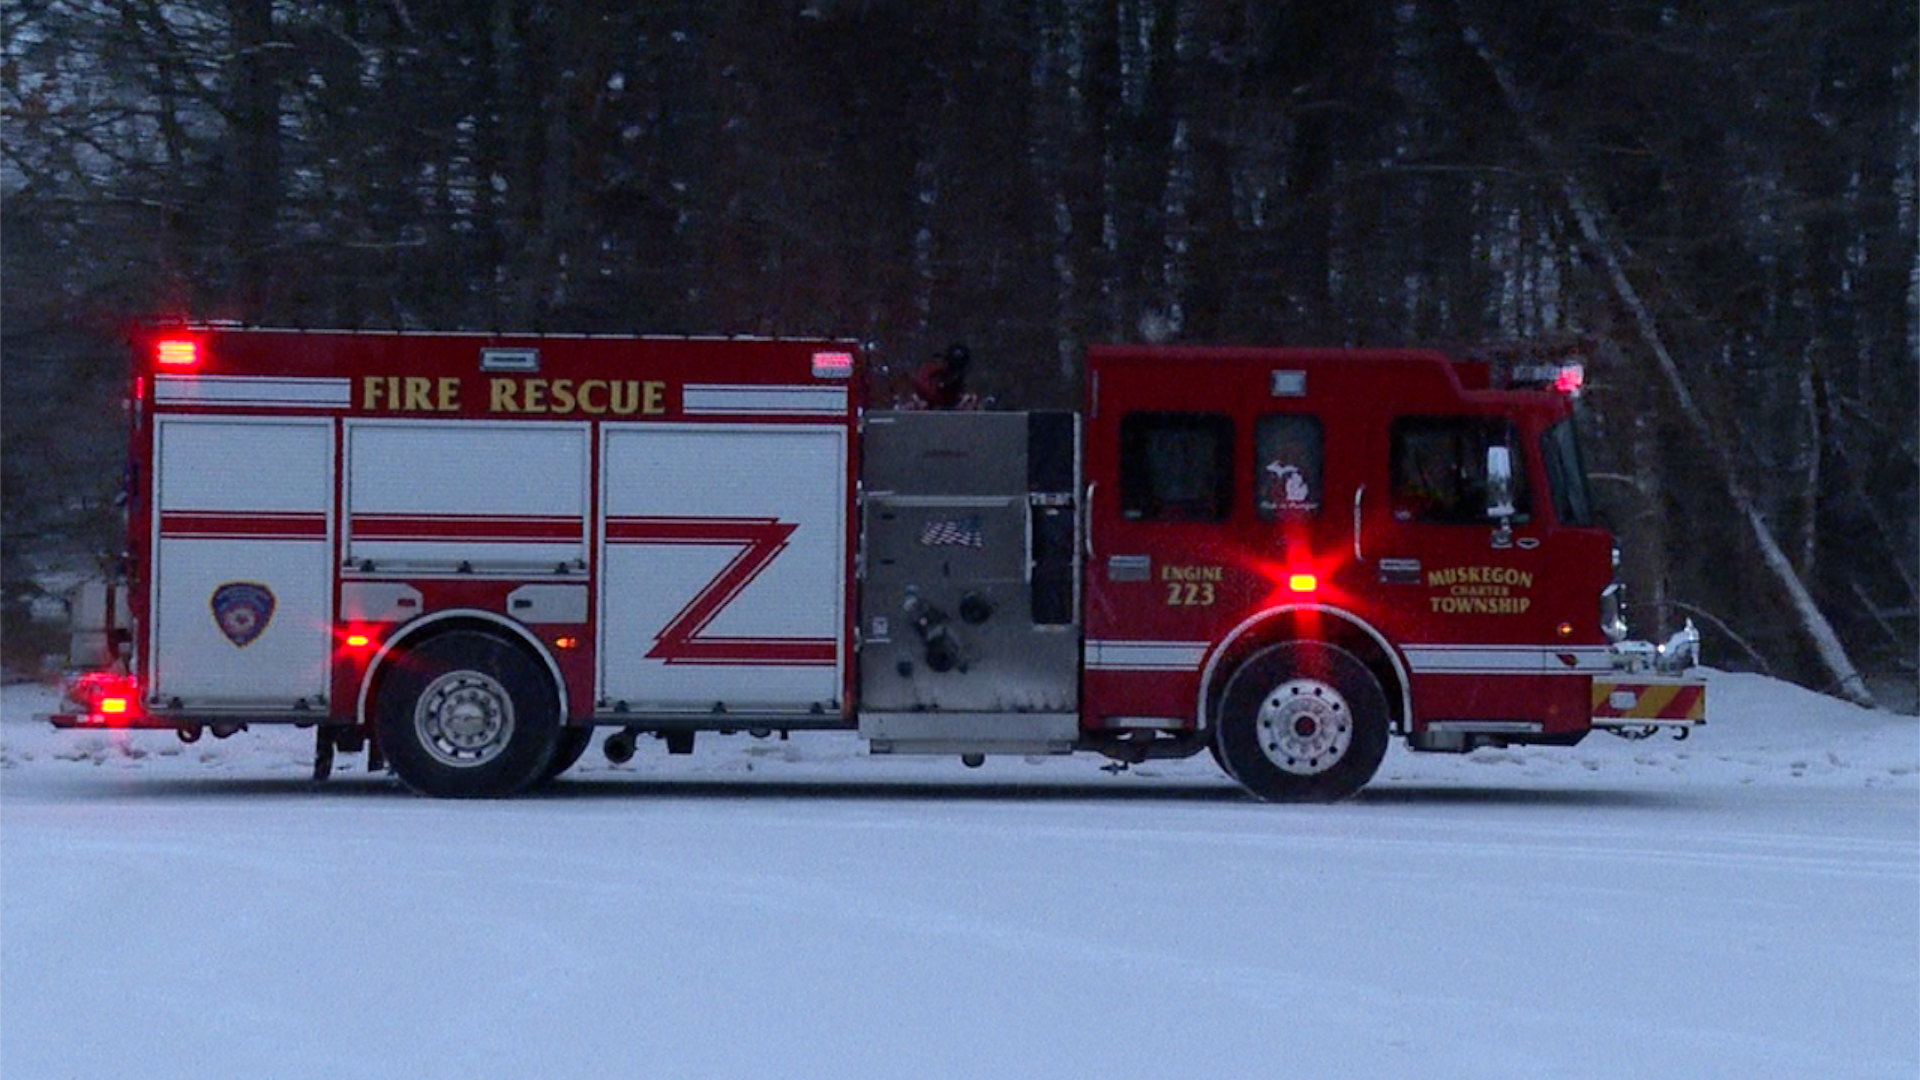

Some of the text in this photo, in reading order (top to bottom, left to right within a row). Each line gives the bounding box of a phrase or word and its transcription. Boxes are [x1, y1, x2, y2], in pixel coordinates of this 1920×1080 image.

[362, 376, 667, 415] FIRE RESCUE
[1161, 566, 1224, 581] ENGINE
[1427, 566, 1534, 588] MUSKEGON
[1167, 583, 1215, 606] 223
[1450, 585, 1510, 596] CHARTER
[1430, 596, 1531, 614] TOWNSHIP
